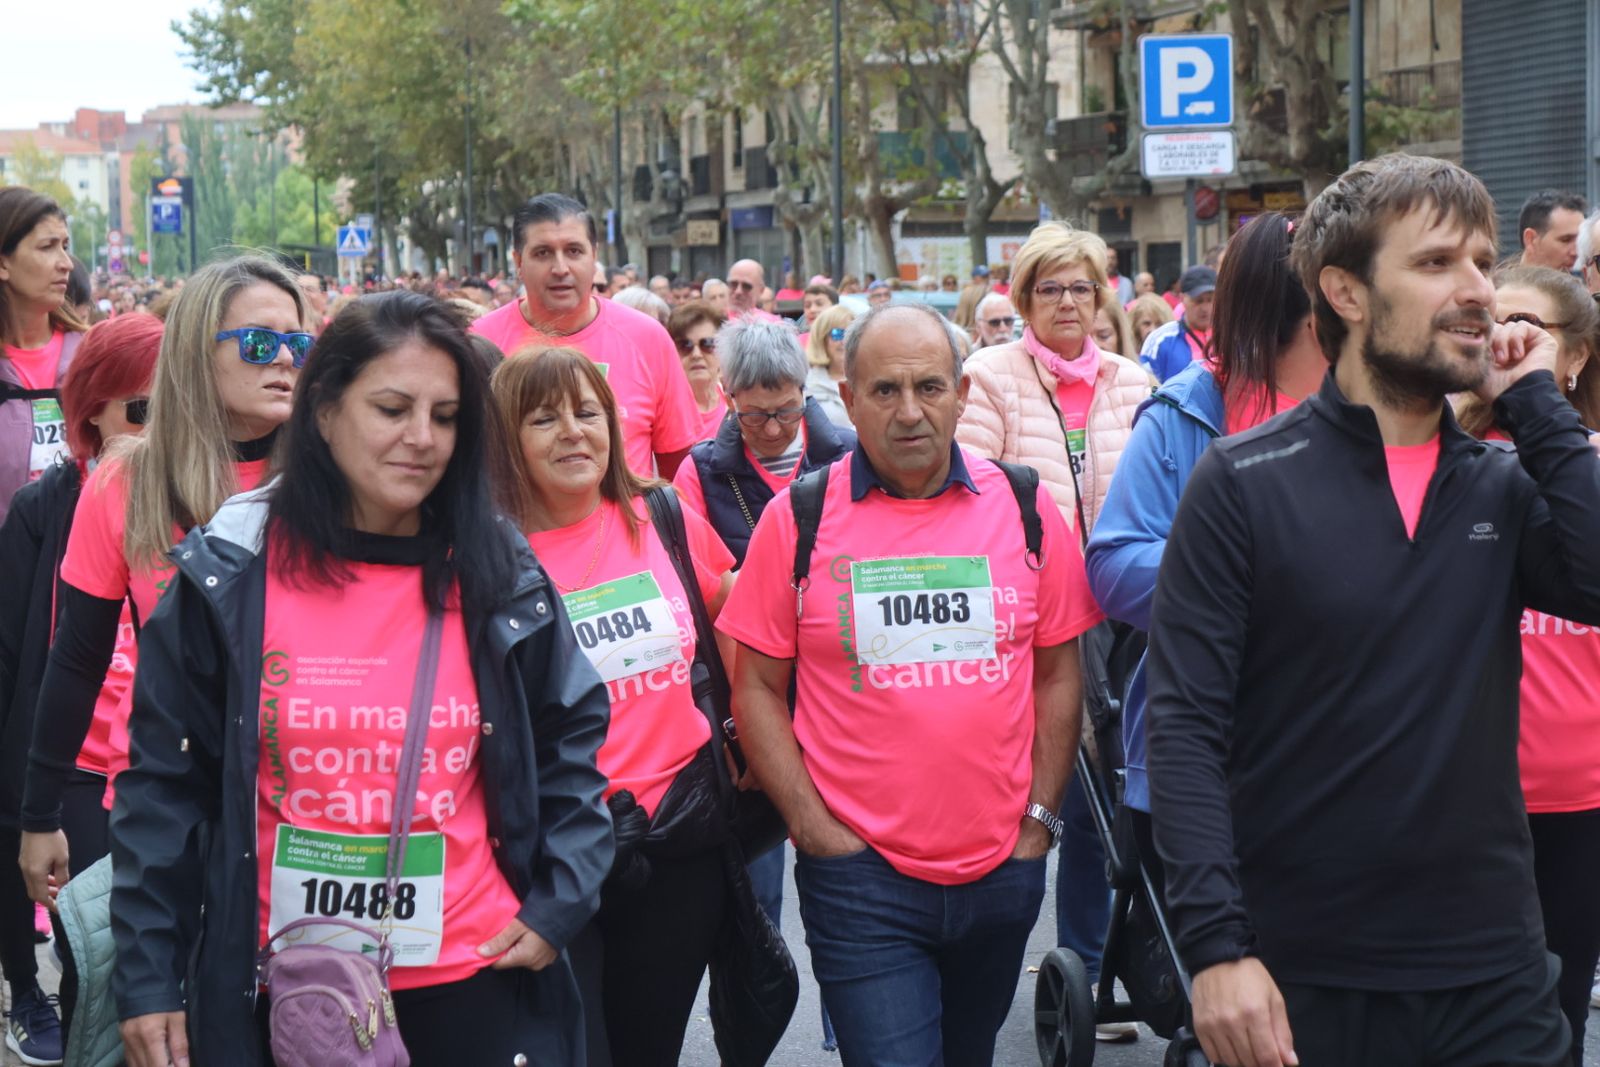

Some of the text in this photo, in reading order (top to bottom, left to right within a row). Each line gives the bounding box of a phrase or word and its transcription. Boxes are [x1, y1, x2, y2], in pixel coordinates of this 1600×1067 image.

[1159, 46, 1215, 118] P
[161, 204, 172, 220] P
[878, 592, 971, 626] 10483
[575, 606, 652, 649] 0484
[296, 666, 327, 675] contra
[296, 676, 362, 686] en Salamanca
[287, 696, 480, 729] En macha
[263, 697, 288, 811] ALAMANCA
[445, 735, 476, 774] el
[289, 778, 457, 825] cánce
[287, 846, 368, 864] contra el cáncer
[289, 834, 342, 852] Salamanca
[301, 877, 417, 921] 10488
